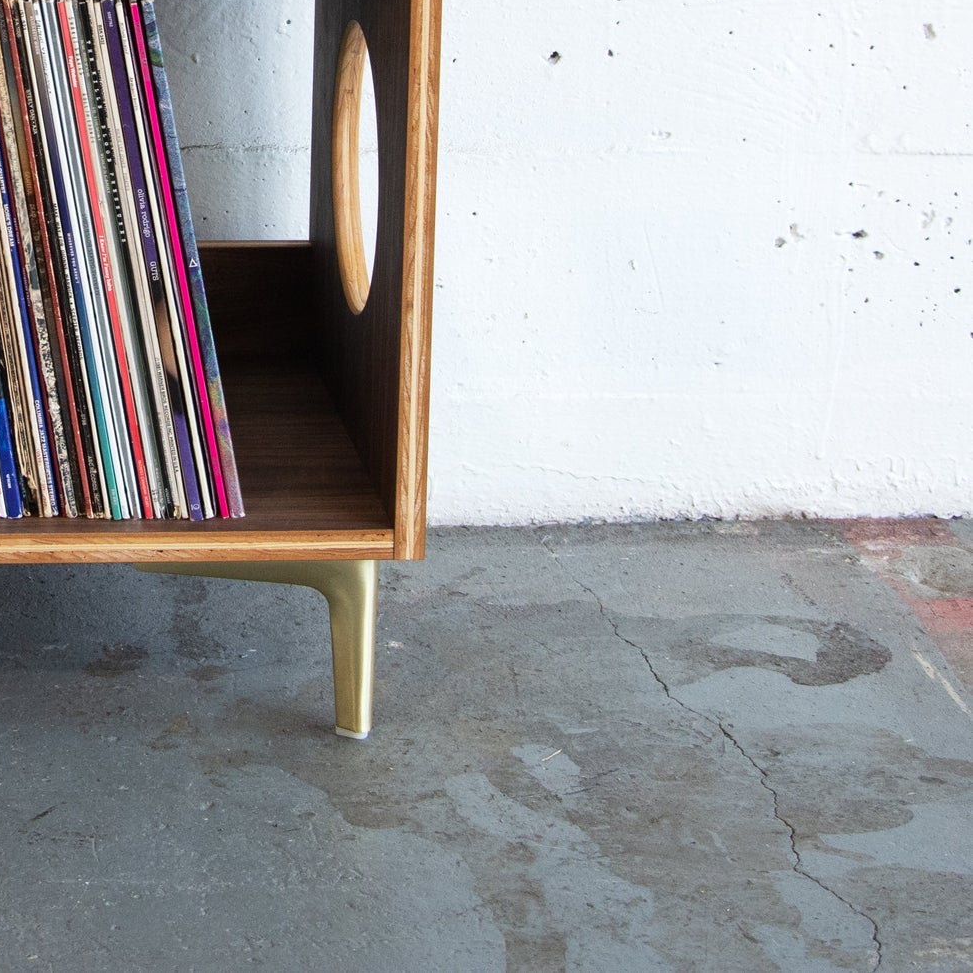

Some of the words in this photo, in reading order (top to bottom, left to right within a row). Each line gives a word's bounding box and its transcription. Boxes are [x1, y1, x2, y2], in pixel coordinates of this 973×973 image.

[70, 68, 80, 88] Webster
[24, 90, 33, 109] STEELY
[86, 41, 94, 62] THE
[91, 72, 103, 109] KILLS
[101, 125, 112, 163] BLOOD
[109, 173, 126, 243] PRESSURES
[136, 189, 147, 209] olivia
[2, 204, 11, 226] MONK'S
[7, 227, 16, 246] DREAM
[140, 211, 152, 237] rodrigo
[149, 261, 160, 281] GUTS
[34, 400, 44, 428] COLUMBIA
[41, 444, 52, 484] MASTERPIECES
[48, 485, 56, 506] STEREO
